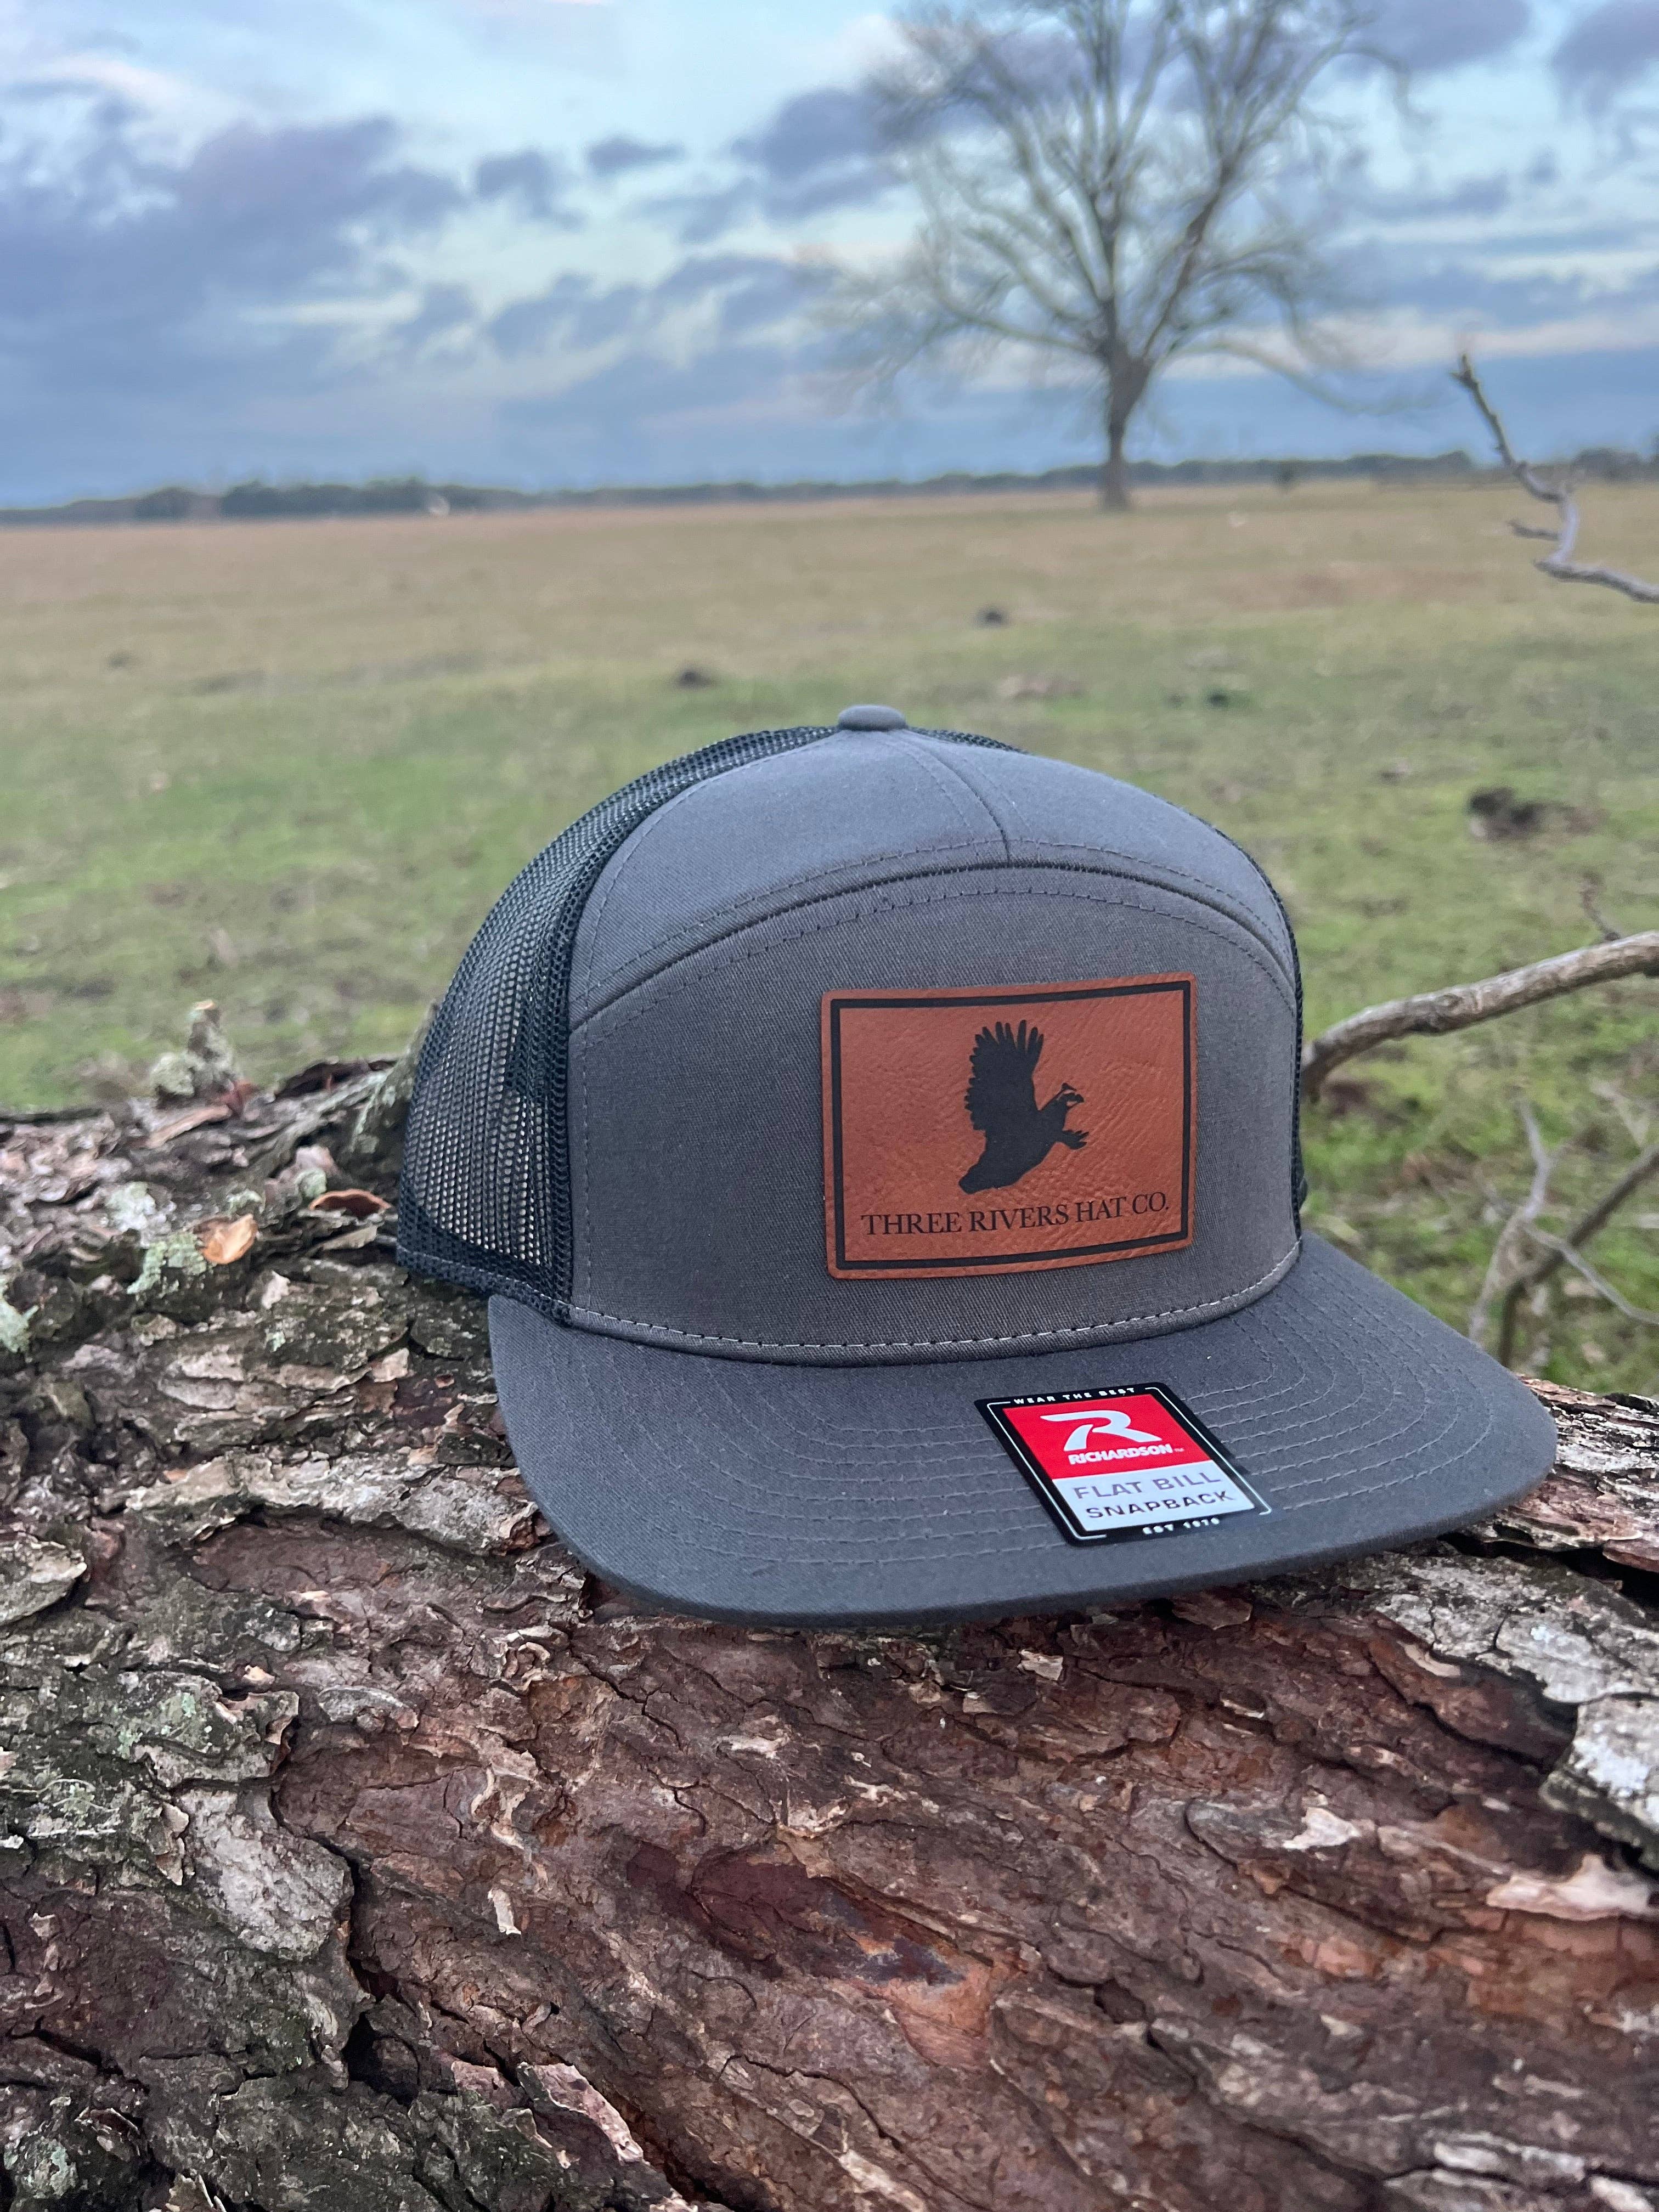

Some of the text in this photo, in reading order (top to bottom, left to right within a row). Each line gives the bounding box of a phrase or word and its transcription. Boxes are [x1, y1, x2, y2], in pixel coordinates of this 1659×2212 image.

[861, 1191, 1170, 1235] THREE RIVERS HAT CO.
[1013, 1396, 1056, 1404] WEAR
[1098, 1387, 1135, 1396] BEST
[1068, 1443, 1173, 1465] RICHARDSON
[1073, 1472, 1221, 1499] FLAT BILL
[1086, 1491, 1234, 1519] SNAPBACK
